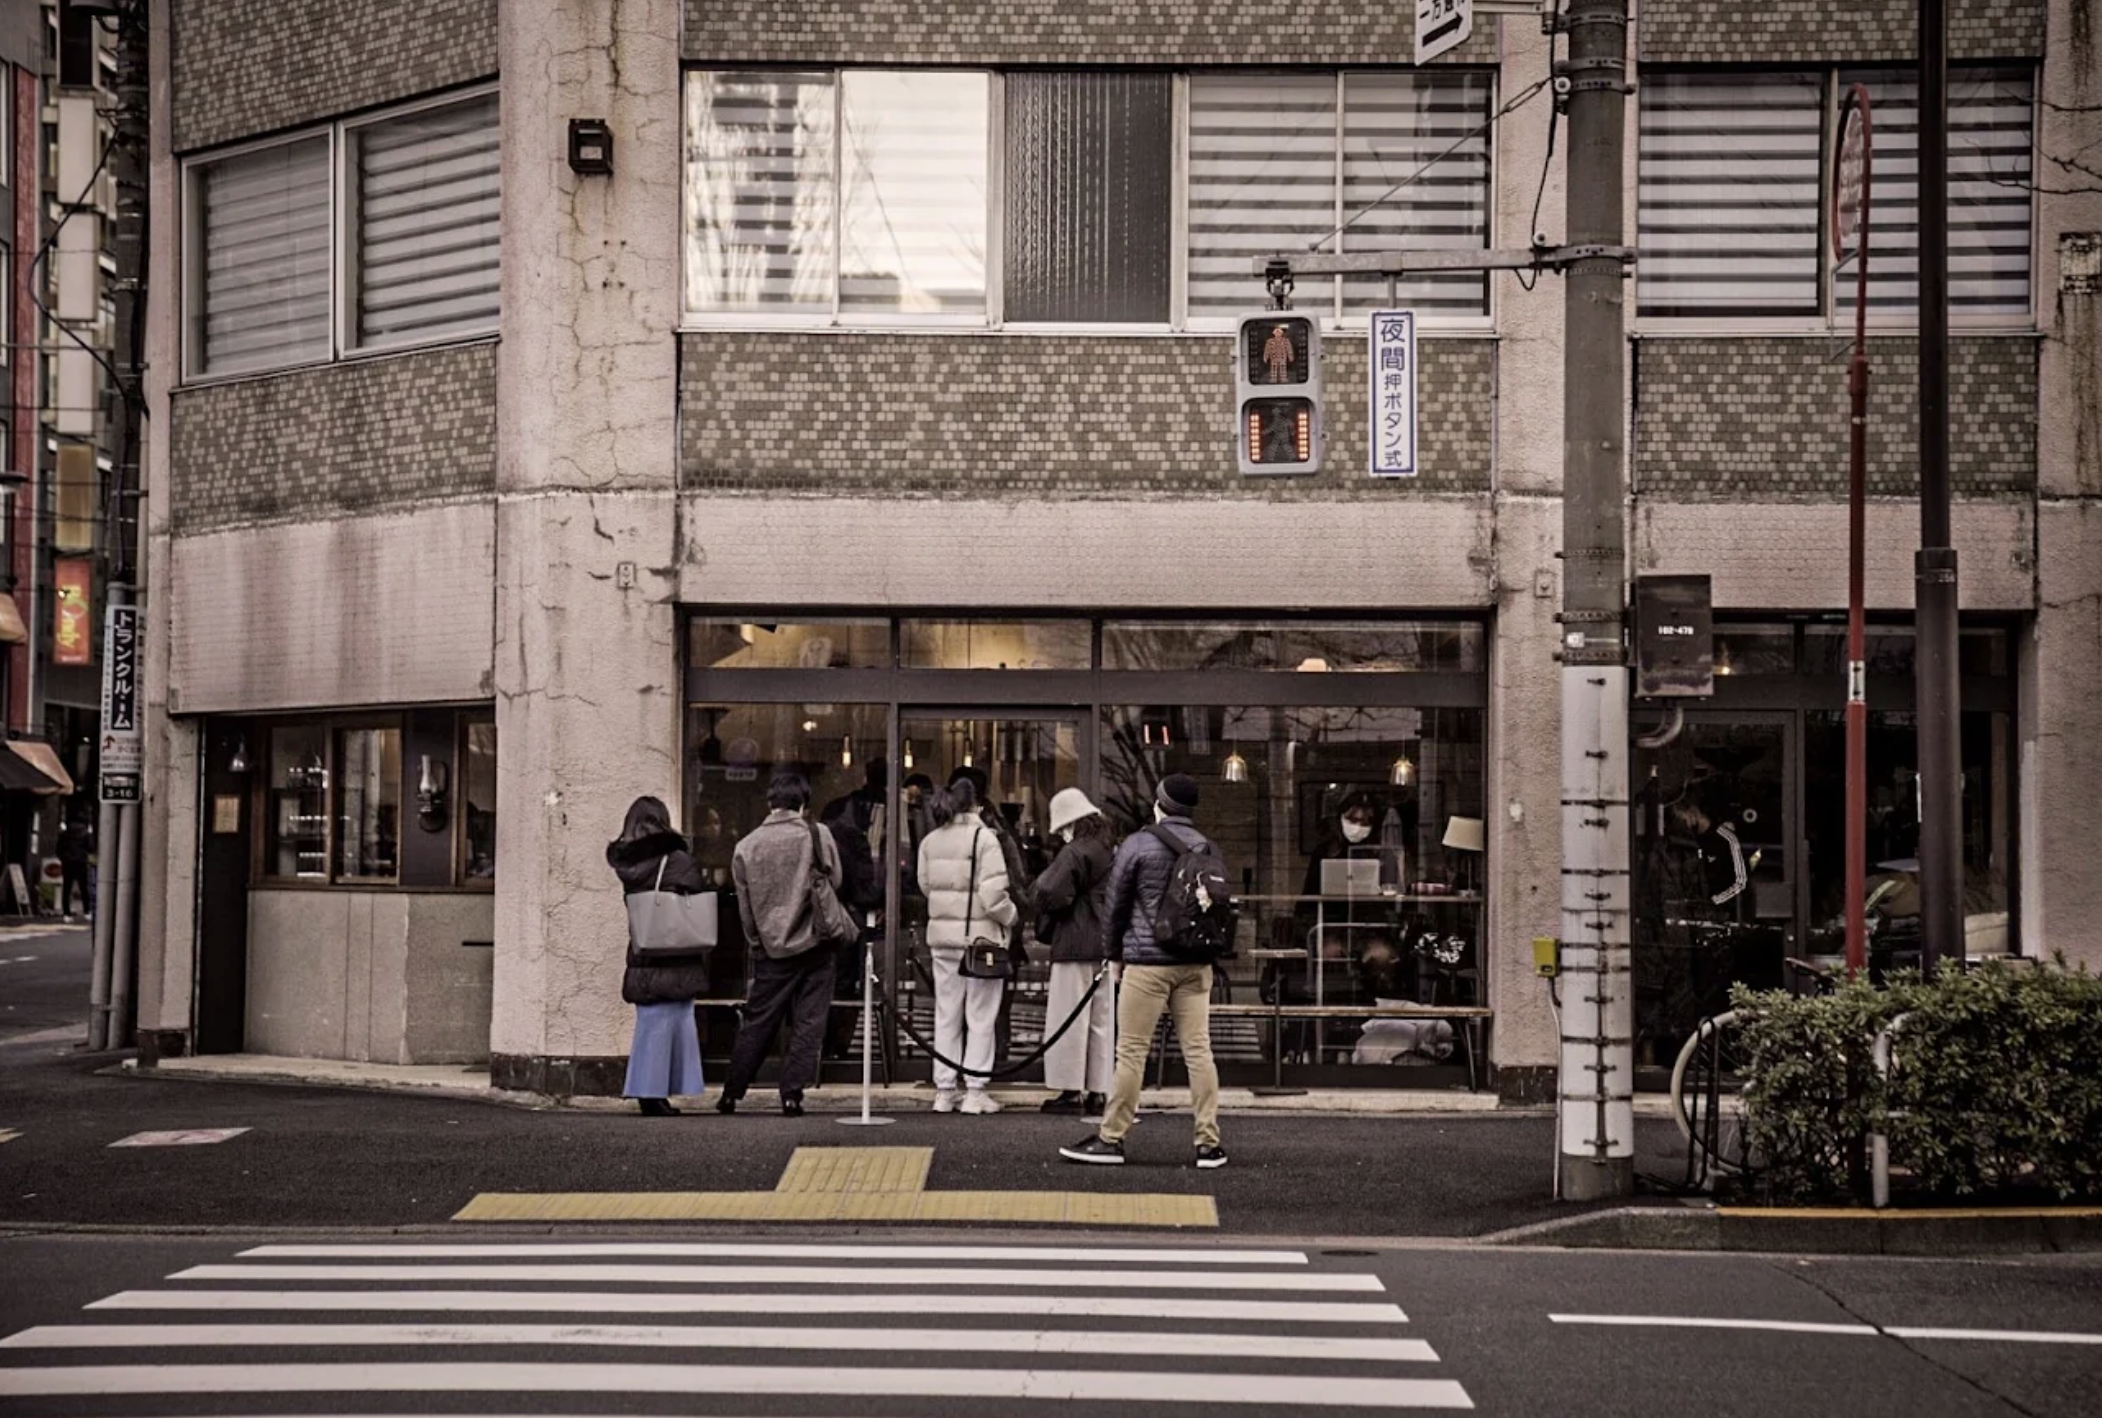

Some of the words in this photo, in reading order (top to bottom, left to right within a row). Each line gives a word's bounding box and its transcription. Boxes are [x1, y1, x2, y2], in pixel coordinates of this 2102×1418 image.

[1380, 318, 1405, 467] 夜間押ボタン式
[114, 612, 132, 728] トランクルーム
